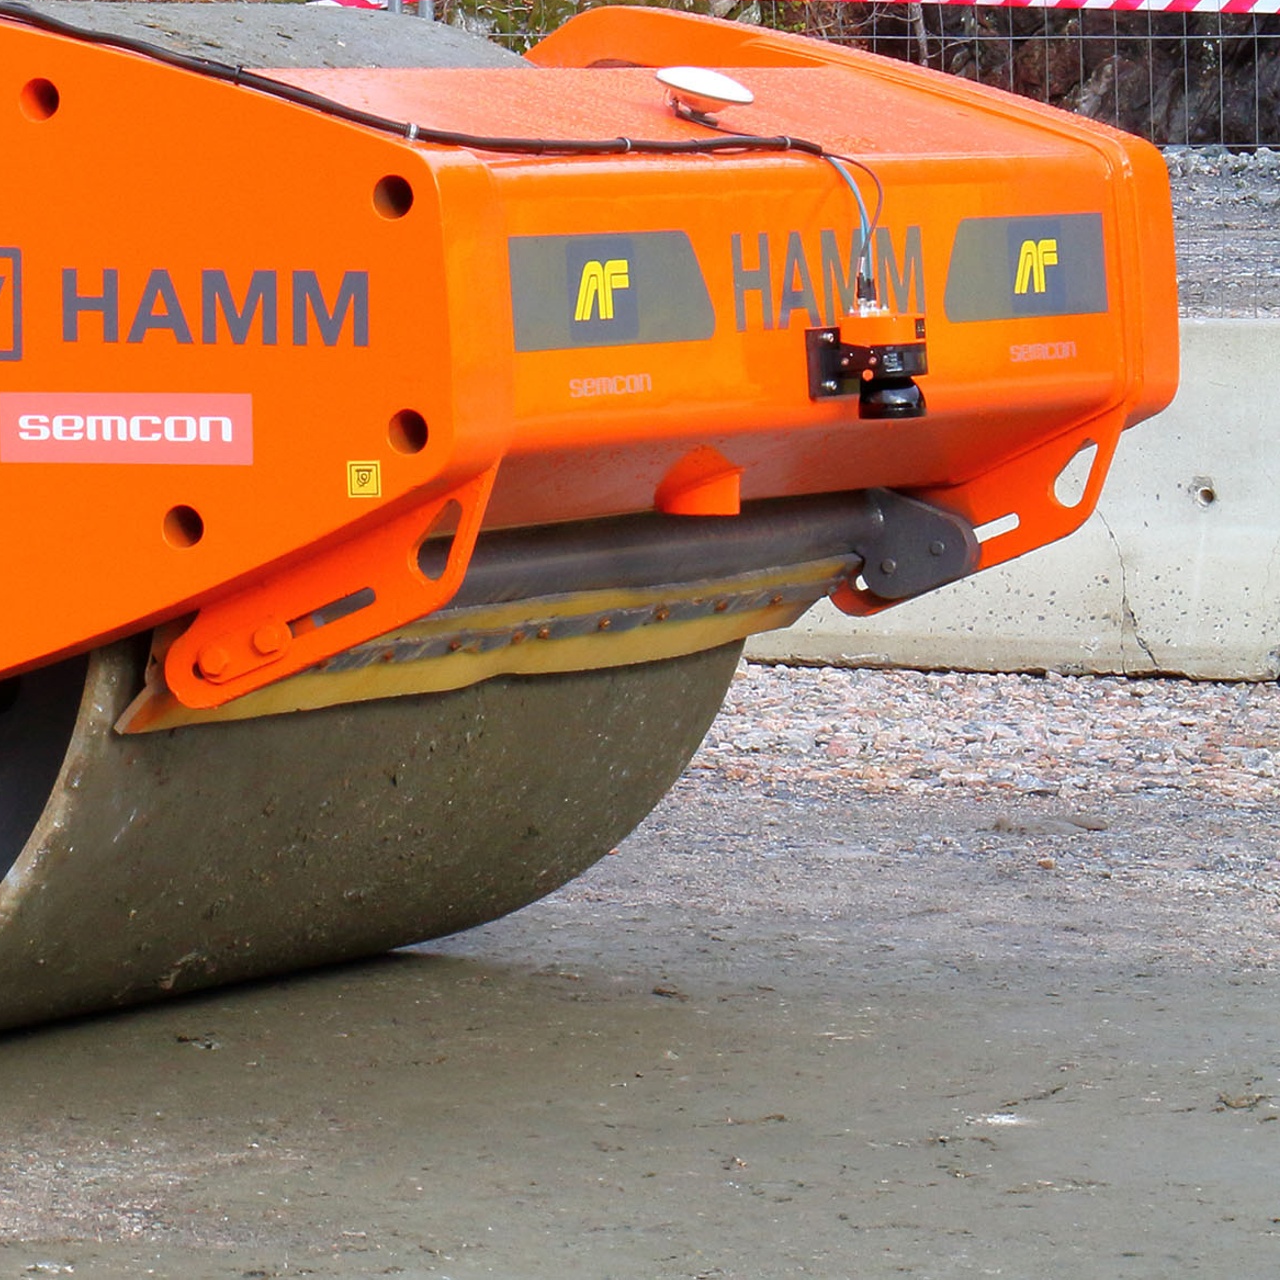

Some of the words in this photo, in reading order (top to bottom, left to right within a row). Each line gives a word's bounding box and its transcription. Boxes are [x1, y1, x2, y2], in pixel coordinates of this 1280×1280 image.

[573, 258, 630, 322] AF
[730, 225, 927, 333] HAMM
[1013, 238, 1059, 295] AF
[60, 267, 370, 348] HAMM
[1009, 341, 1077, 363] semcon
[569, 373, 652, 399] semcon
[17, 413, 234, 443] semcon
